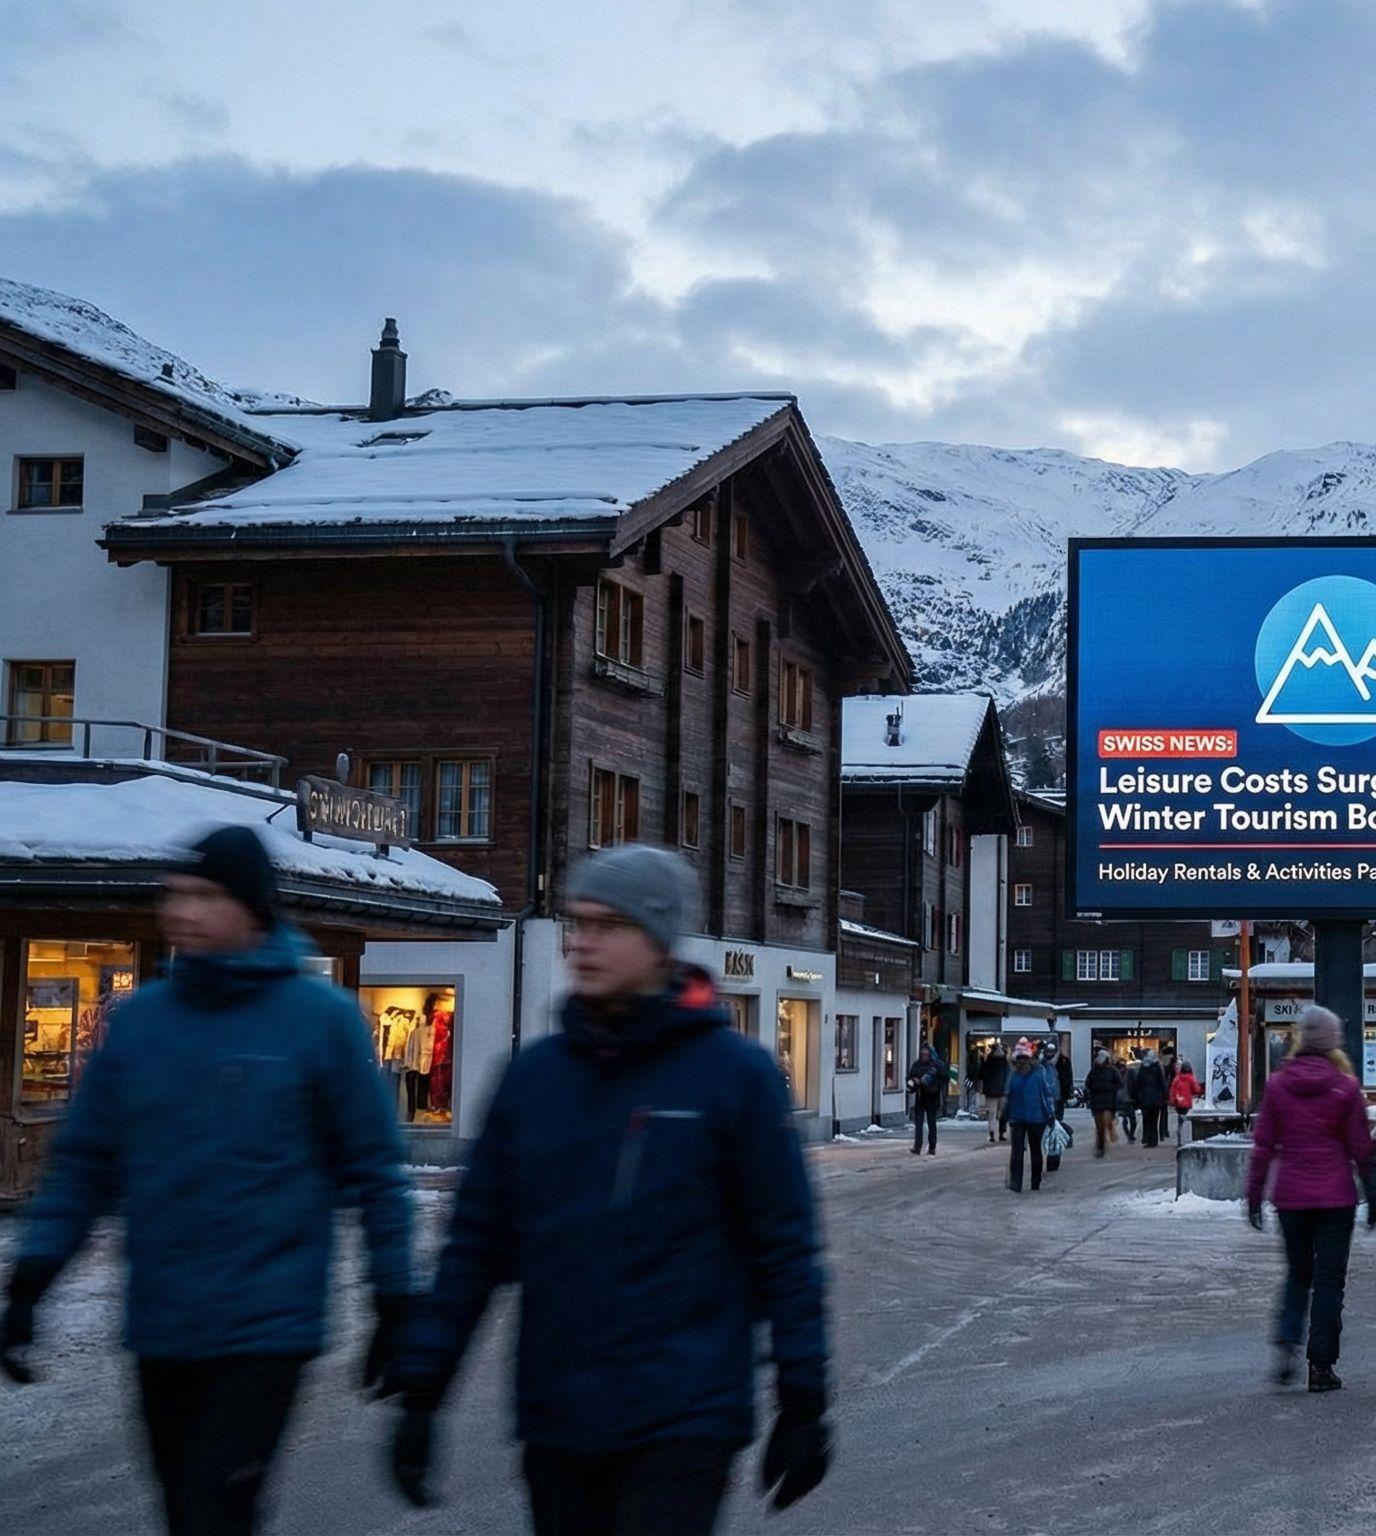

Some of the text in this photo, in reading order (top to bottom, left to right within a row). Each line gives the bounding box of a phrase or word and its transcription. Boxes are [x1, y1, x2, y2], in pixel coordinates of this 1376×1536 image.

[1103, 735, 1233, 752] SWISS NEWS:
[1100, 766, 1213, 794] Leisure
[1220, 766, 1309, 794] Costs
[1098, 803, 1206, 831] Winter
[1213, 802, 1337, 831] Tourism
[1099, 862, 1169, 884] Holiday
[1174, 862, 1242, 881] Rentals
[1246, 862, 1261, 880] &
[1265, 862, 1352, 880] Activities
[1274, 1004, 1292, 1015] SKI
